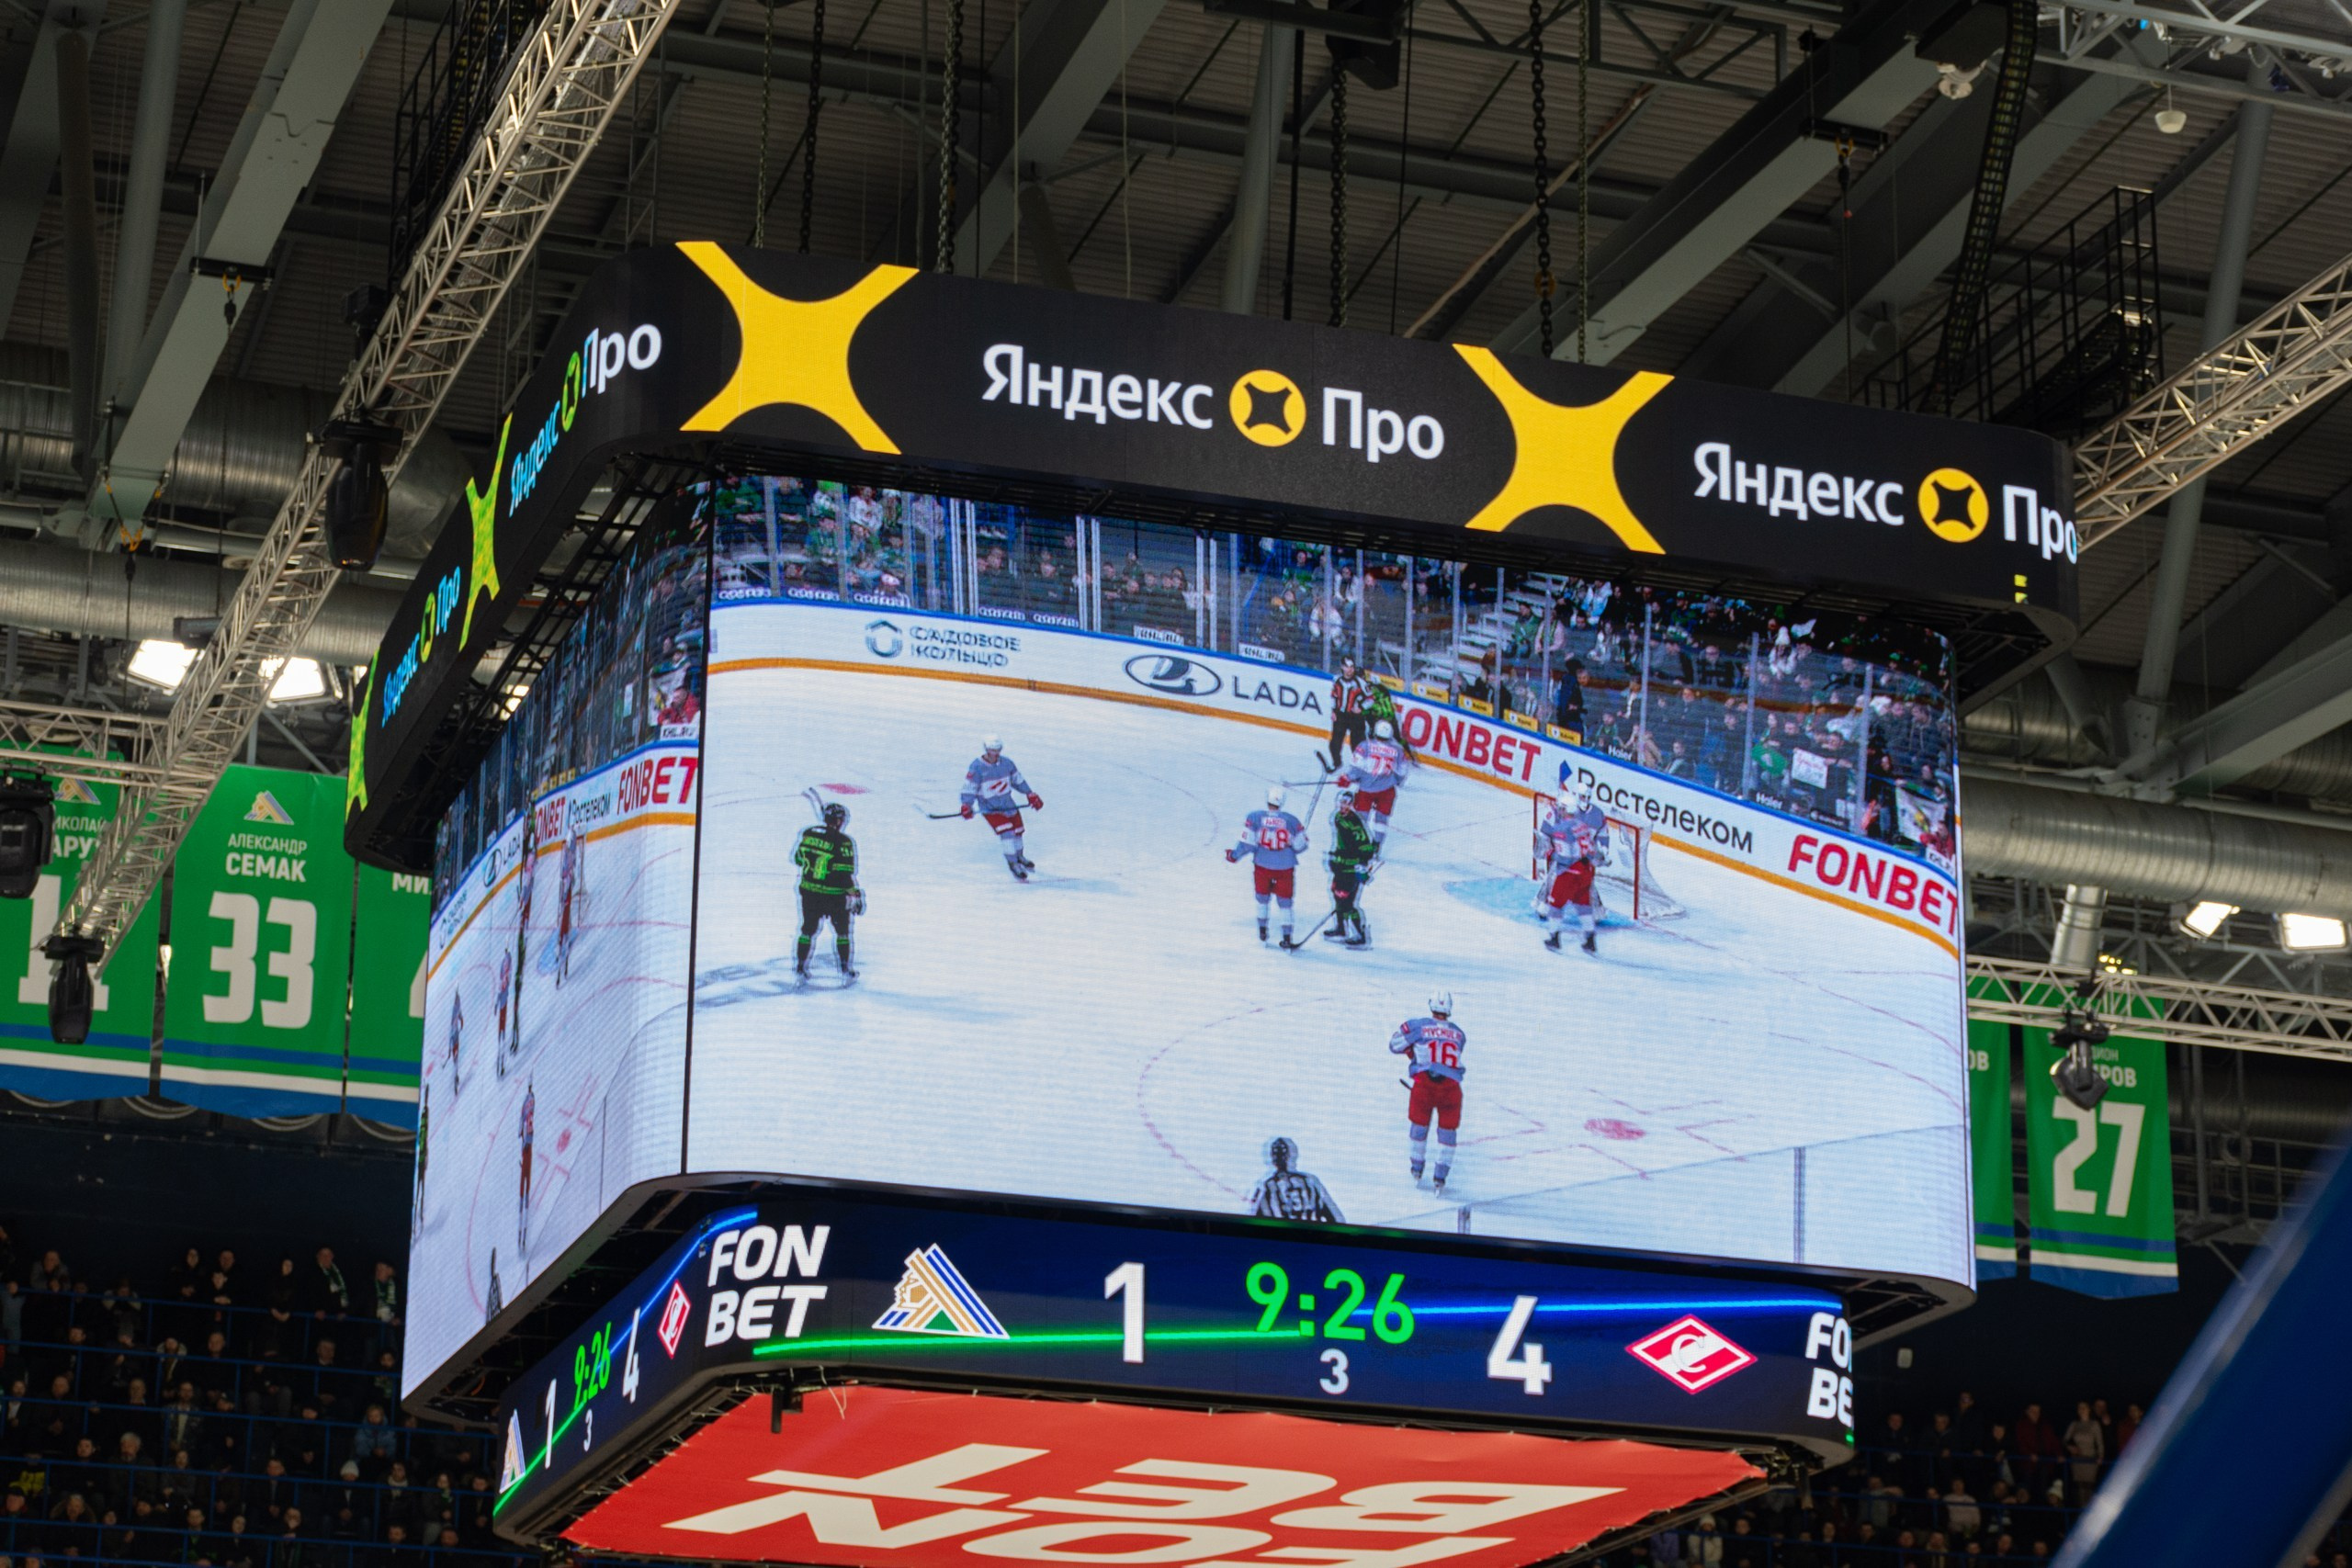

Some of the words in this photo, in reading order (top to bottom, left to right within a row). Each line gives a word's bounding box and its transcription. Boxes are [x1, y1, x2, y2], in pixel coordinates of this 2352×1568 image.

[510, 400, 560, 518] Яндекс
[582, 323, 662, 399] Про
[982, 344, 1213, 429] Яндекс
[1323, 387, 1445, 462] Про
[1693, 441, 1905, 526] Яндекс
[2003, 484, 2077, 564] Про
[381, 632, 420, 728] Яндекс
[435, 566, 460, 636] Про
[1231, 675, 1322, 716] LADA
[1395, 703, 1541, 782] ONBET
[616, 756, 699, 815] FONBET
[1577, 767, 1752, 853] Ростелеком
[225, 852, 306, 883] СЕМАК
[227, 833, 308, 854] АЛЕКСАНДР
[1788, 833, 1958, 936] FONBET
[202, 890, 318, 1030] 33
[1428, 1040, 1458, 1068] 16
[2052, 1096, 2145, 1218] 27
[707, 1224, 831, 1286] FON
[705, 1285, 829, 1348] BET
[1103, 1261, 1146, 1364] 1
[1245, 1261, 1416, 1345] 9:26
[1487, 1295, 1553, 1395] 4
[1805, 1312, 1852, 1373] FO
[545, 1379, 557, 1469] 1
[574, 1321, 611, 1411] 9:26
[622, 1307, 641, 1404] 4
[1319, 1348, 1350, 1395] 3
[583, 1409, 593, 1451] 3
